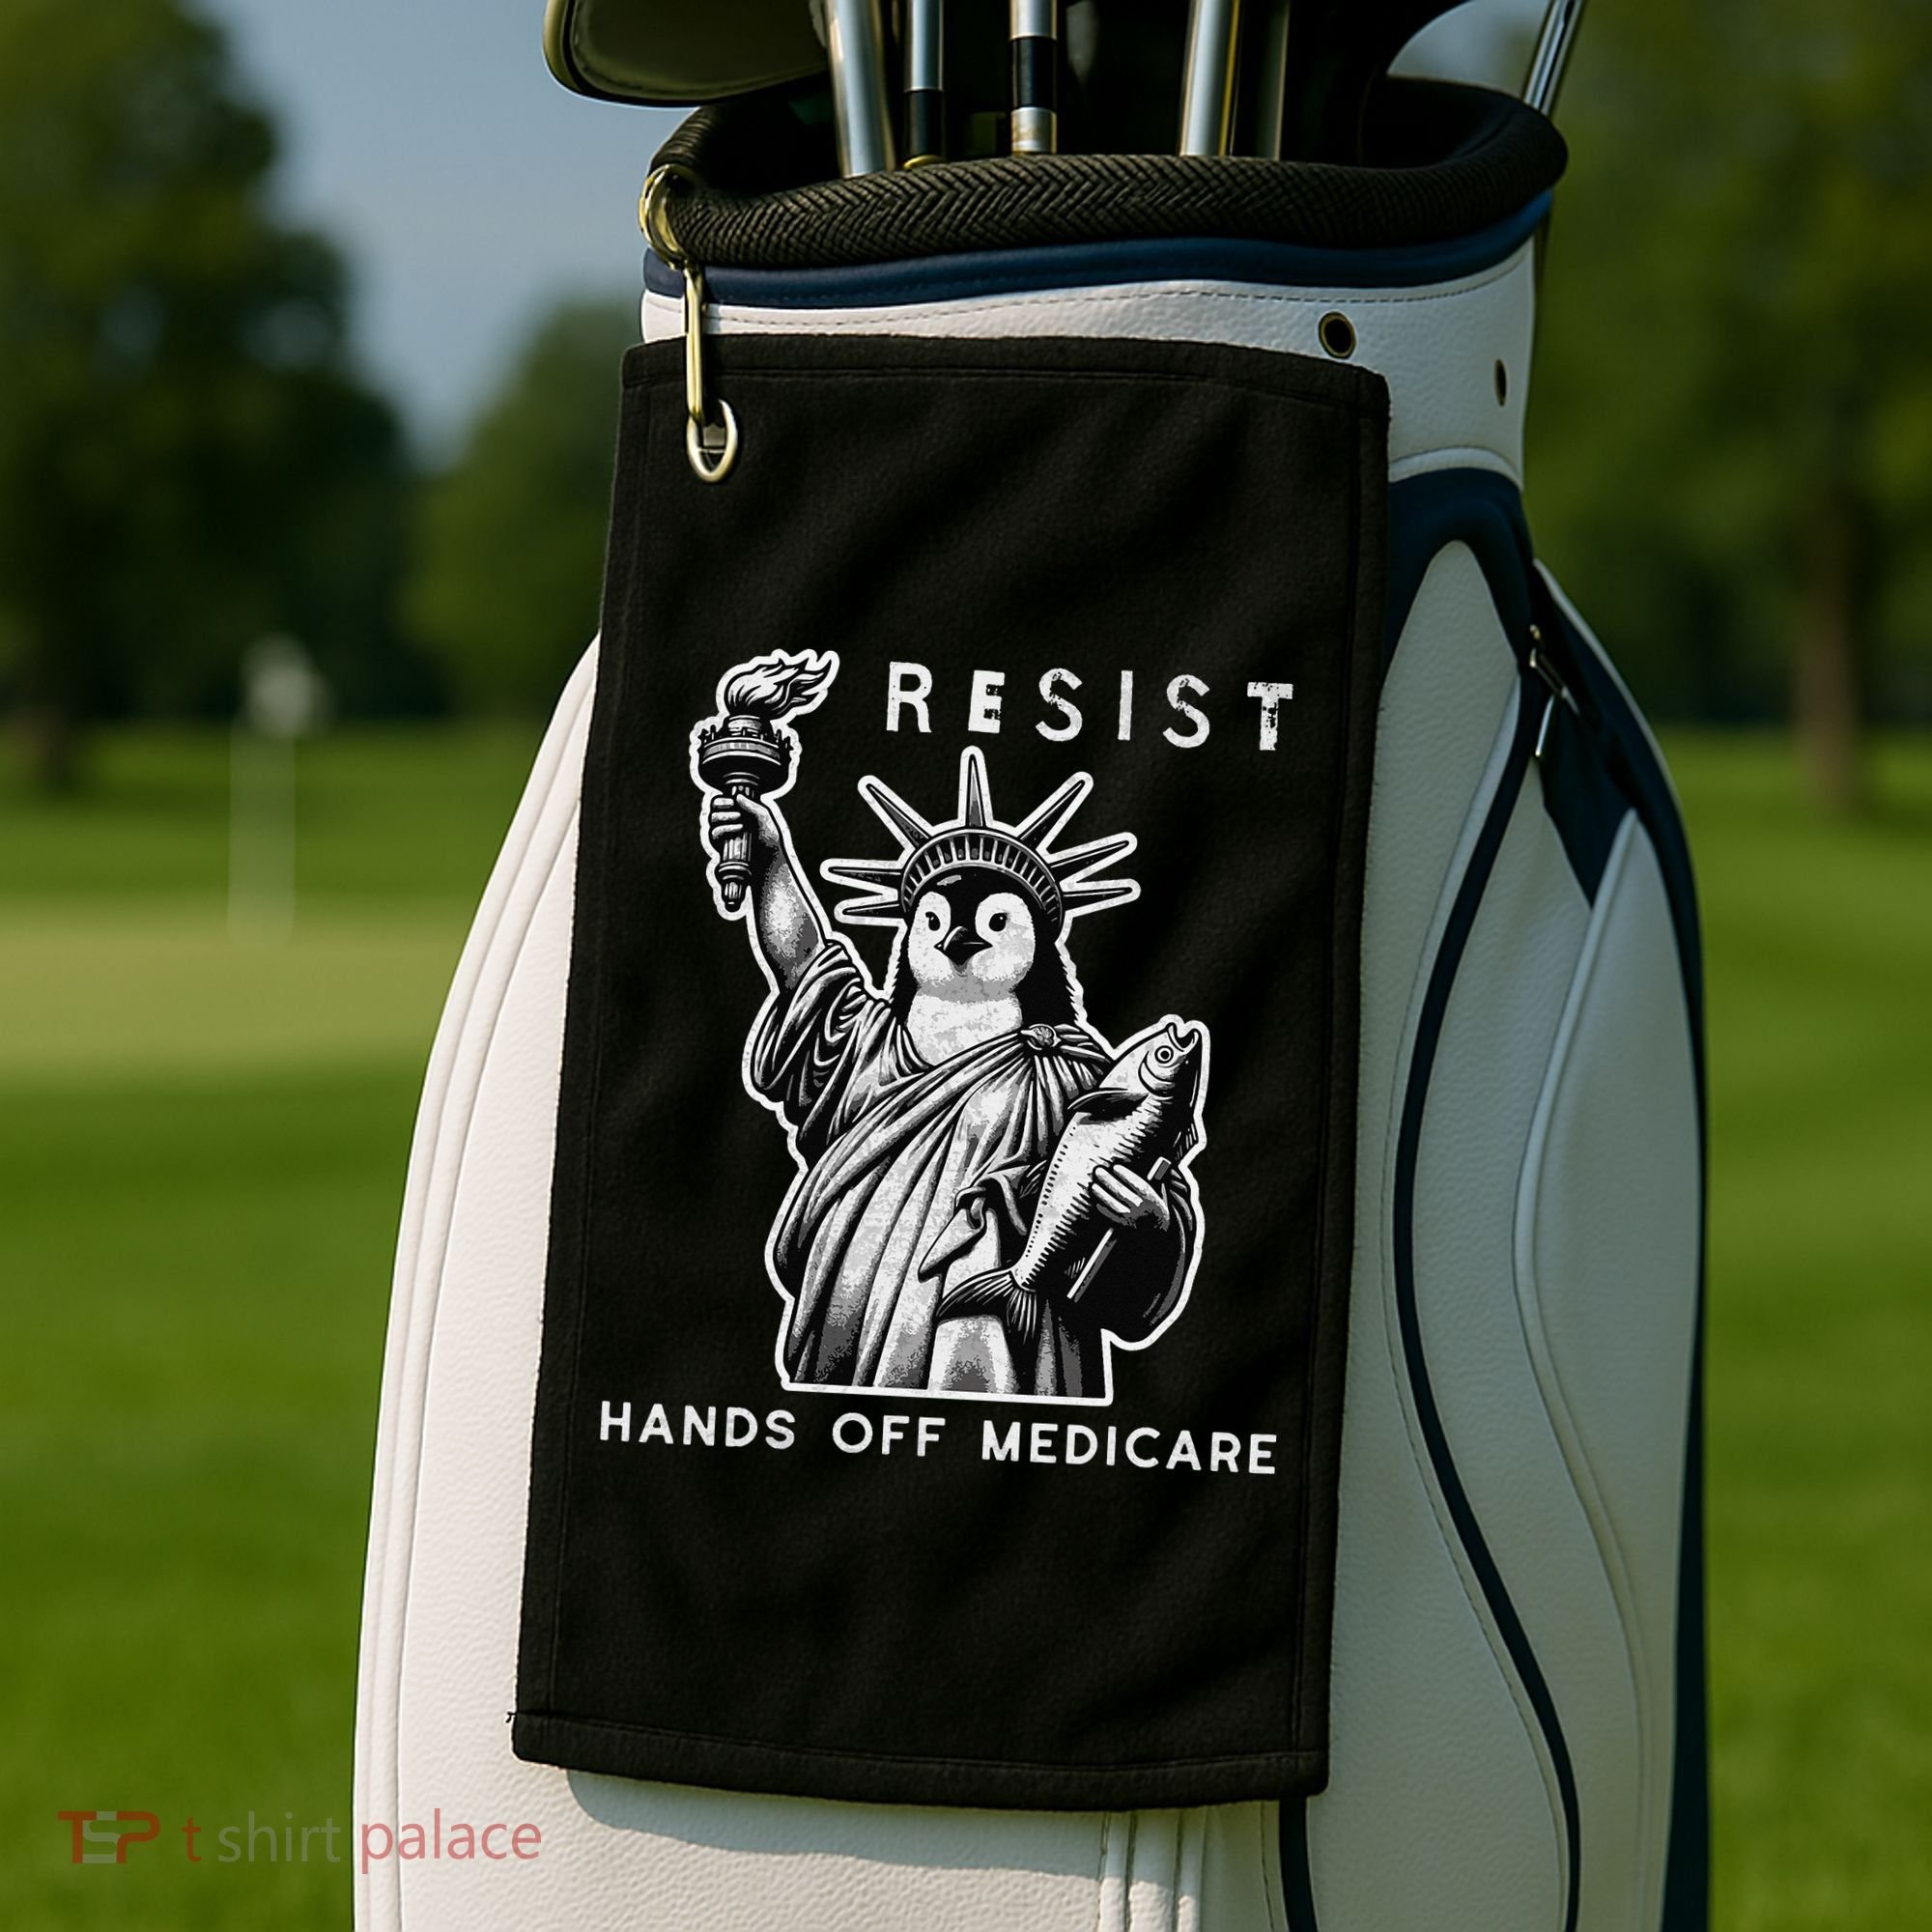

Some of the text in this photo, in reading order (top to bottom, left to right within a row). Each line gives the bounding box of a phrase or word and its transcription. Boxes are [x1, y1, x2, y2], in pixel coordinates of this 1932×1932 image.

[886, 661, 1294, 752] RESIST
[599, 1400, 1277, 1475] HANDS OFF MEDICARE
